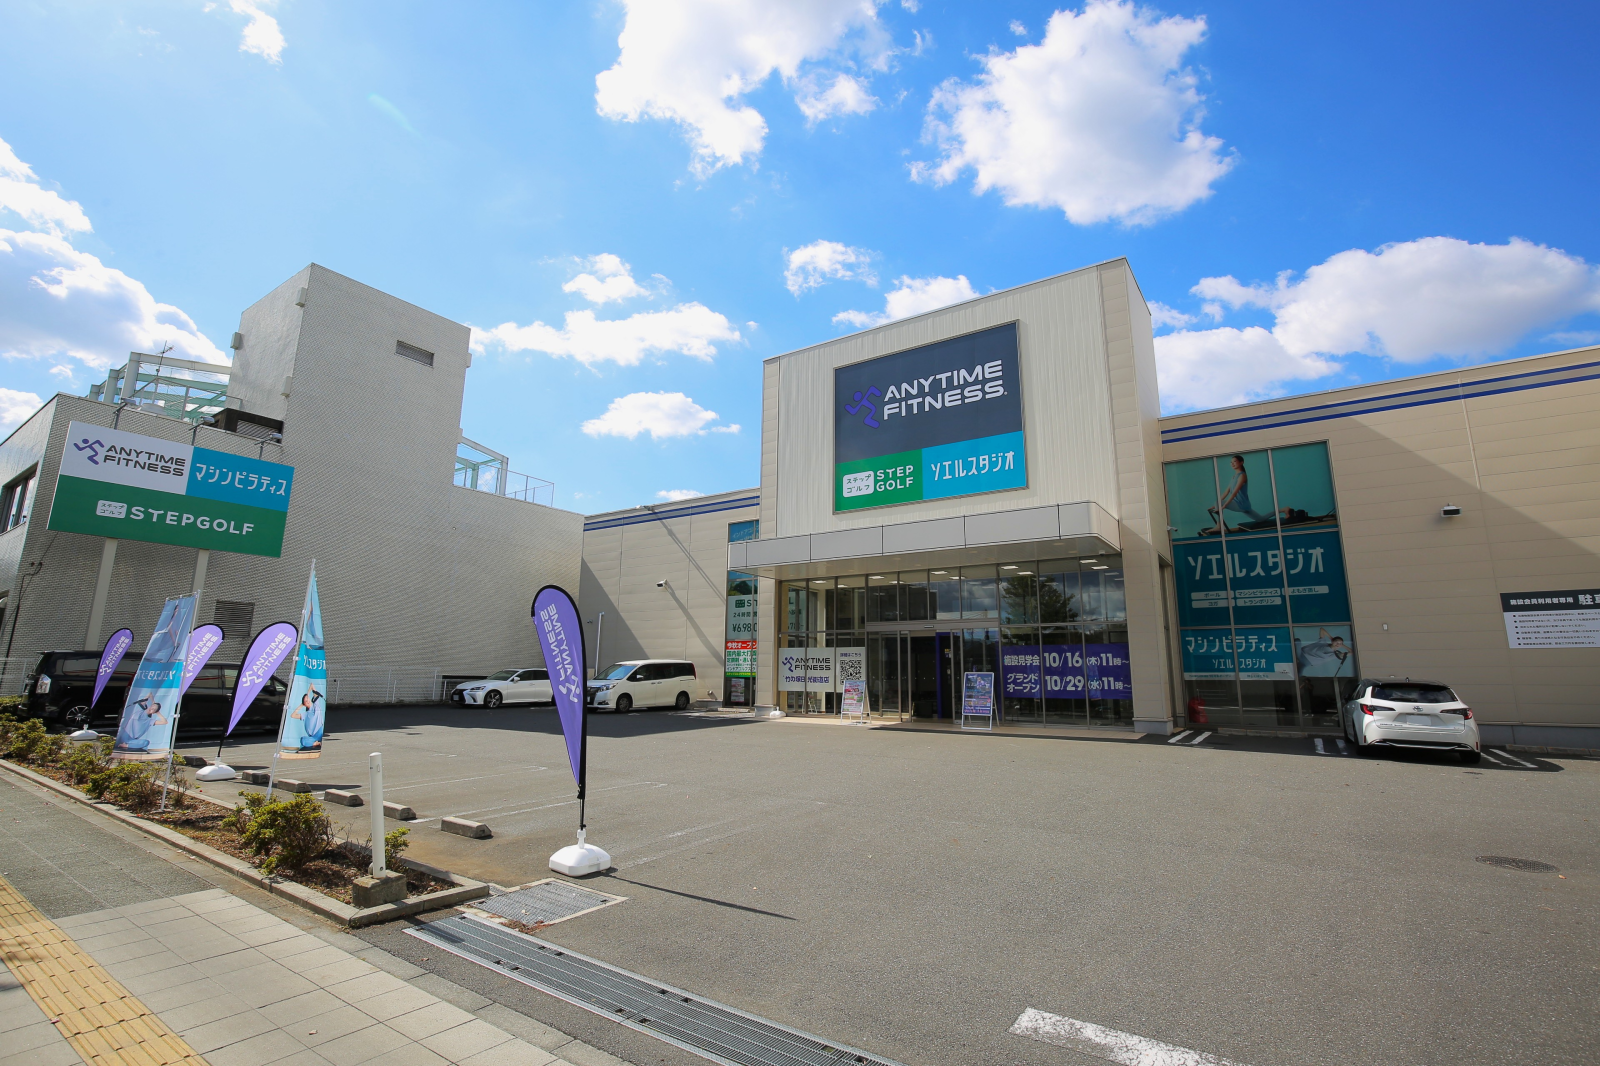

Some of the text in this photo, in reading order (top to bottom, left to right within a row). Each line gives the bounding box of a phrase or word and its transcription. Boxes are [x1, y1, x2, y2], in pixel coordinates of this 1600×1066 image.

[884, 359, 1003, 402] ANYTIME
[883, 379, 1005, 420] FITNESS
[103, 455, 185, 477] FITNESS
[106, 444, 186, 467] ANYTIME
[931, 451, 1015, 481] ソエルスタジオ
[195, 463, 287, 496] マシンピラティス
[846, 473, 872, 485] ステップ
[876, 464, 914, 480] STEP
[846, 484, 870, 494] ゴルフ
[876, 476, 914, 492] GOLF
[99, 508, 123, 516] ゴルフ
[100, 502, 126, 510] ステップ
[129, 505, 255, 536] STEPGOLF
[1187, 546, 1325, 581] ソエルスタジオ
[1237, 589, 1279, 597] マシンピラティス
[105, 634, 126, 667] ANYTIME
[187, 635, 219, 672] FITNESS
[253, 631, 286, 672] ANYTIME
[1185, 634, 1279, 653] マシンピラティス
[108, 637, 131, 673] FITNESS
[257, 636, 292, 678] FITNESS
[1004, 654, 1041, 666] 施設見学会
[1212, 658, 1267, 669] ソエルスタジオ
[1006, 672, 1039, 683] グランド
[1006, 683, 1040, 693] オープン
